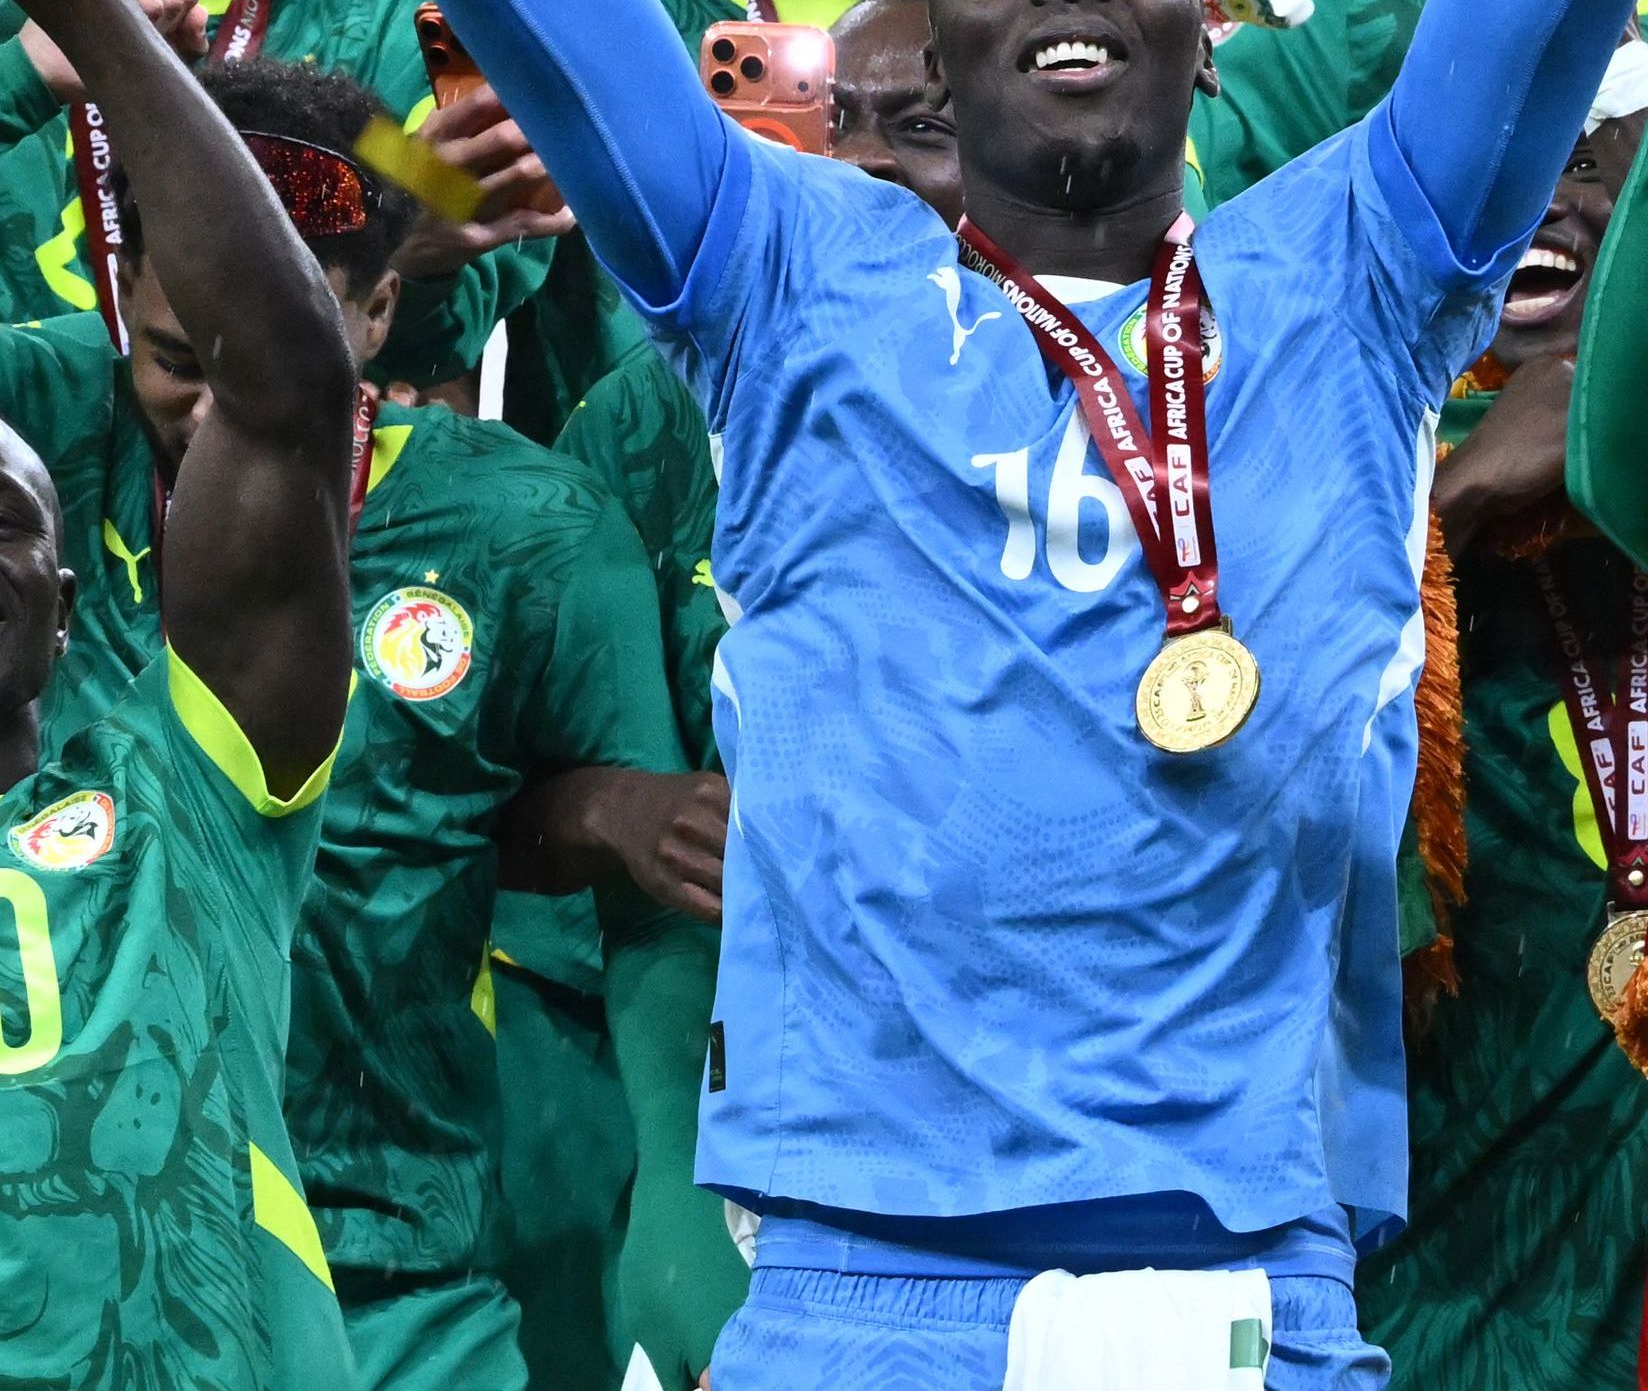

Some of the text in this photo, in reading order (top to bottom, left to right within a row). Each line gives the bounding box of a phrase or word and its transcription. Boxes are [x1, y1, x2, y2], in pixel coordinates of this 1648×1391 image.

[90, 129, 110, 170] CUP
[1001, 279, 1062, 337] NATIONS
[1049, 322, 1079, 348] OF
[1162, 311, 1183, 343] OF
[1068, 343, 1104, 377] CUP
[1163, 344, 1186, 380] CUP
[1093, 377, 1138, 452] AFRICA
[1167, 381, 1189, 440] AFRICA
[971, 400, 1143, 593] 16
[1172, 456, 1190, 517] CAF
[1632, 596, 1648, 636] CUP
[1571, 660, 1604, 731] AFRICA
[1630, 639, 1648, 714] AFRICA
[1631, 735, 1646, 795] CAF
